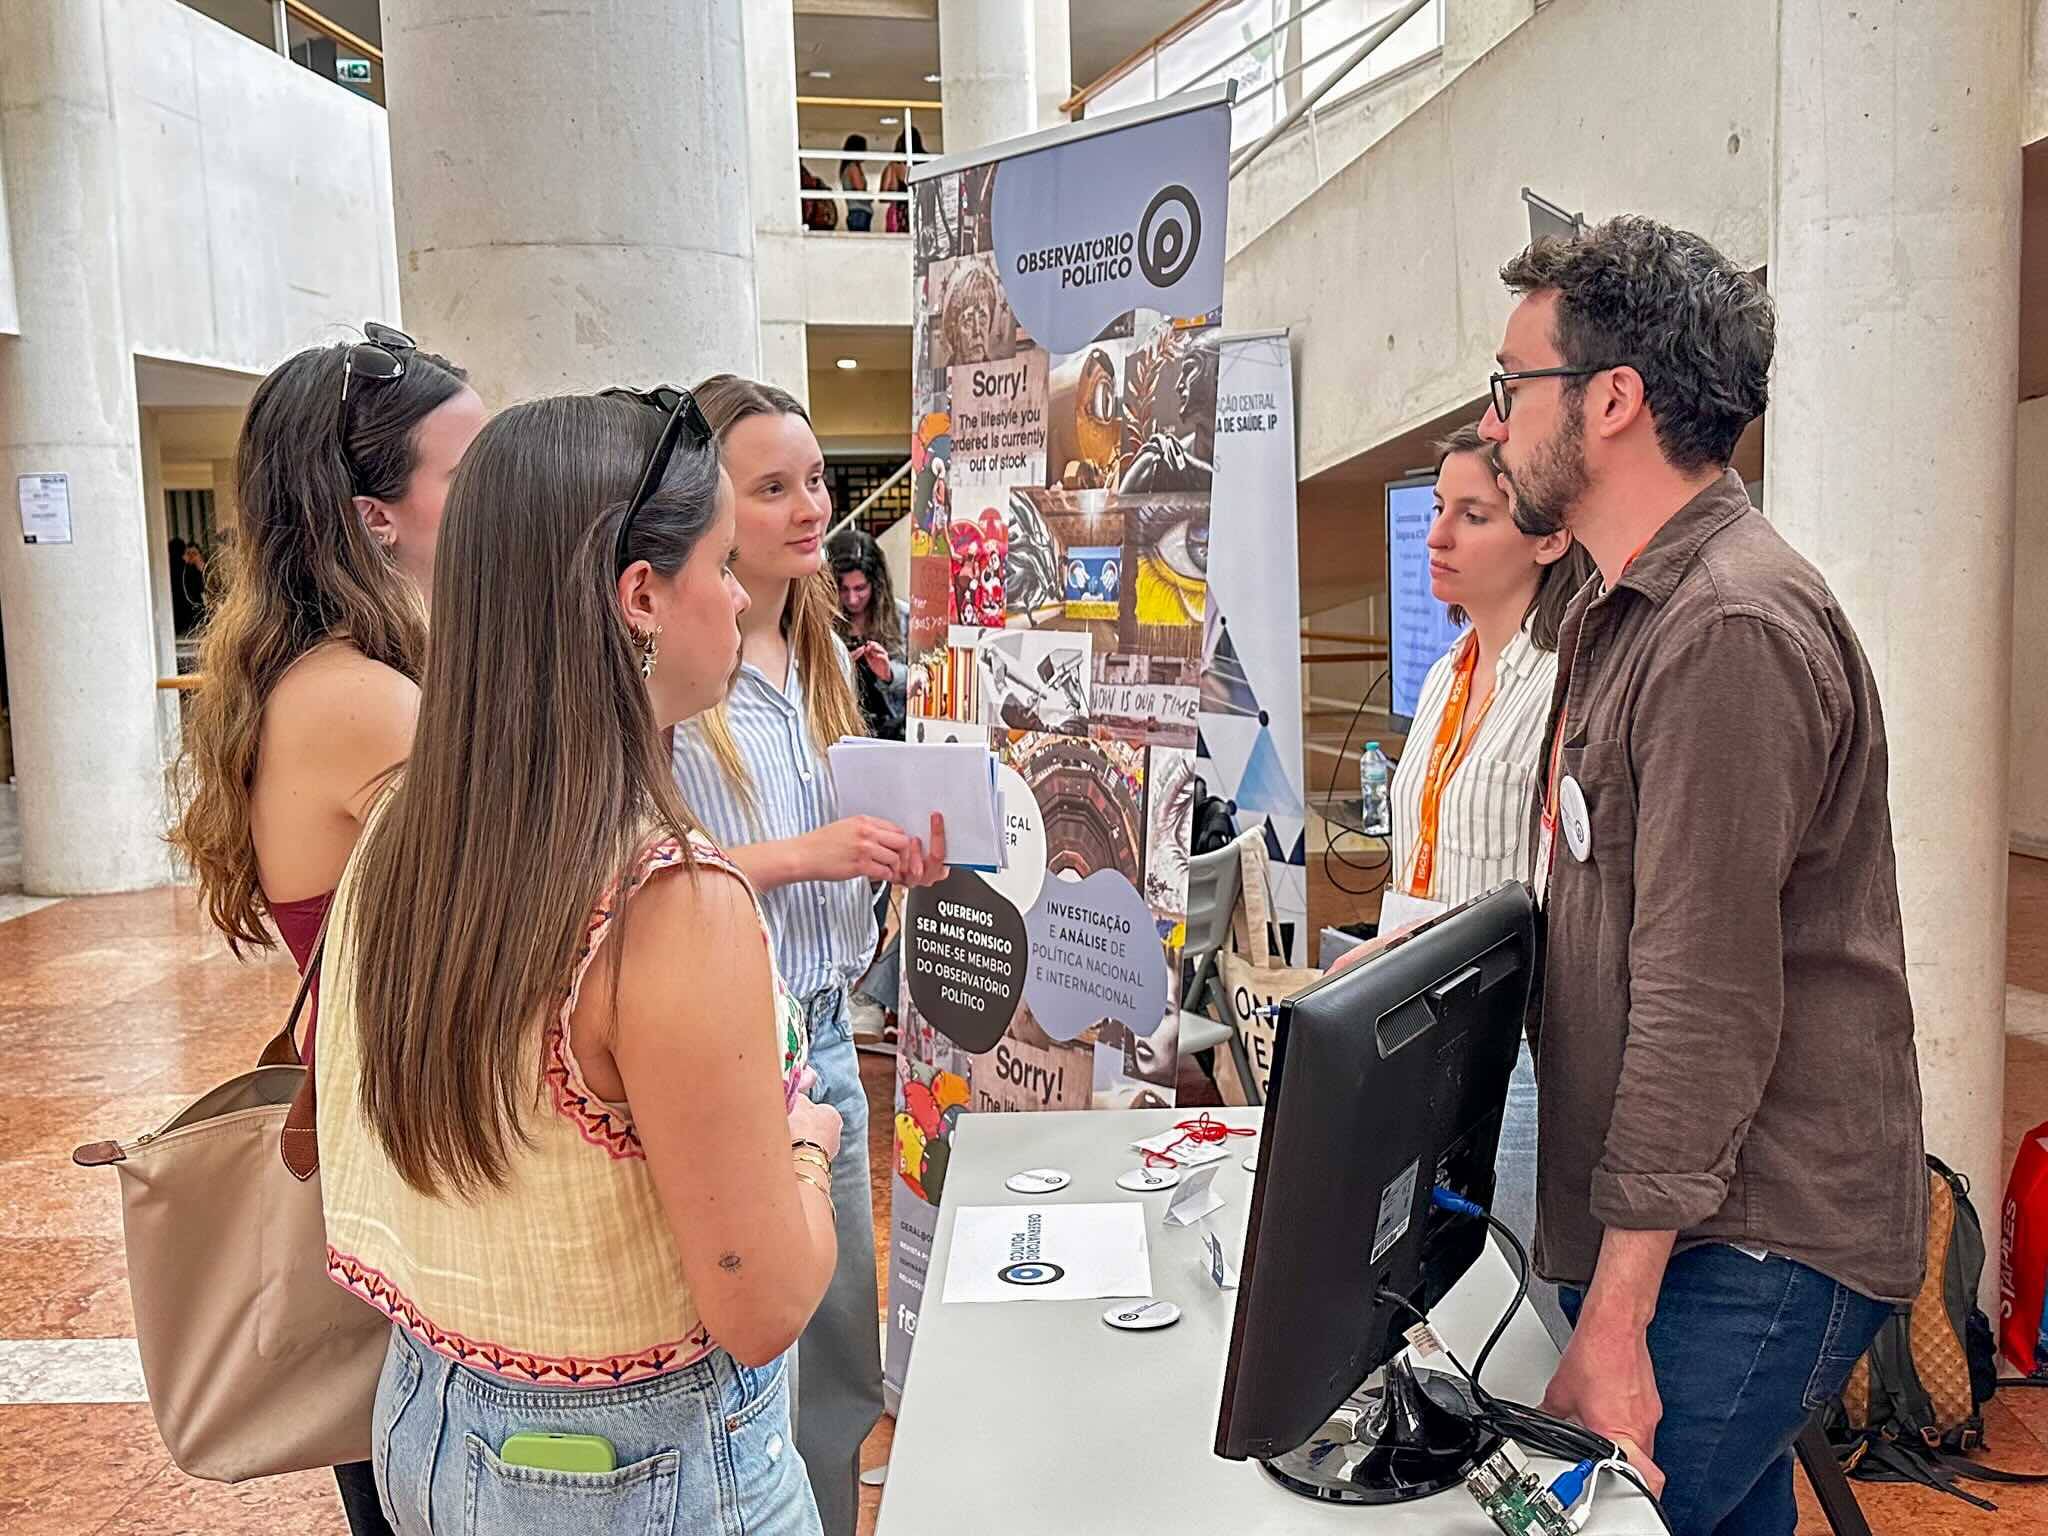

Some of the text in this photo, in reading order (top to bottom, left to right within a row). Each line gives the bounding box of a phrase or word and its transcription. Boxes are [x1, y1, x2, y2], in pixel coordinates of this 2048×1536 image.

[972, 364, 1027, 400] Sorry!
[960, 408, 1041, 429] The lifestyle you
[1224, 417, 1235, 432] DE
[1268, 414, 1277, 430] IP
[951, 427, 1046, 452] ordered is currently
[969, 451, 1027, 472] out of stock
[1121, 690, 1131, 712] IS
[1135, 693, 1156, 712] OUR
[1162, 693, 1199, 720] TIME
[1006, 815, 1031, 831] ICAL
[938, 900, 993, 927] QUEREMOS
[1047, 901, 1130, 934] INVESTIGAÇÃO
[917, 917, 1012, 955] SER MAIS CONSIGO
[1049, 924, 1126, 958] E ANÁLISE DE
[916, 937, 1011, 976] TORNE-SE MEMBRO
[1032, 943, 1144, 987] POLÍTICA NACIONAL
[917, 958, 1010, 998] DO OBSERVATÓRIO
[1036, 967, 1136, 1010] E INTERNACIONAL
[941, 985, 985, 1012] POLÍTICO
[996, 1044, 1064, 1105] Sorry!
[979, 1090, 1001, 1112] The
[2000, 1199, 2016, 1319] STAPLES
